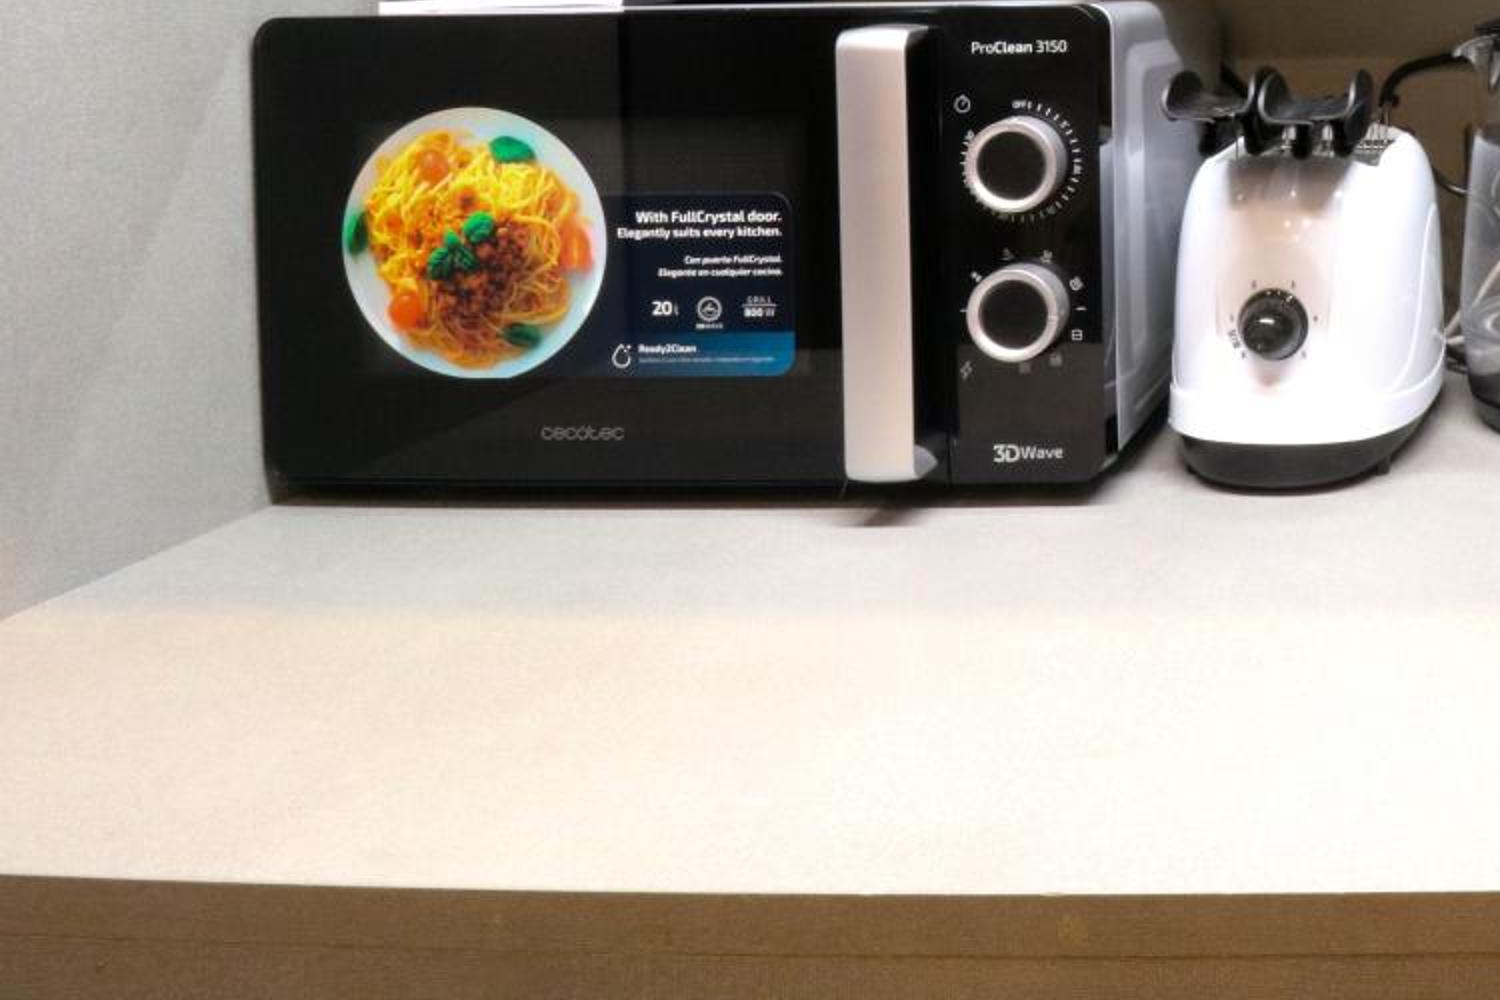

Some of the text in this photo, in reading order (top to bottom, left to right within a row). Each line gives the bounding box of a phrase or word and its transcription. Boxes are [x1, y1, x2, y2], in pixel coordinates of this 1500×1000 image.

[971, 40, 1068, 54] ProClean 3150
[635, 210, 783, 226] With FullCrystal door.
[617, 226, 783, 240] Elegantly suits every kitchen.
[651, 301, 673, 316] 20
[638, 343, 697, 354] Ready2Clean
